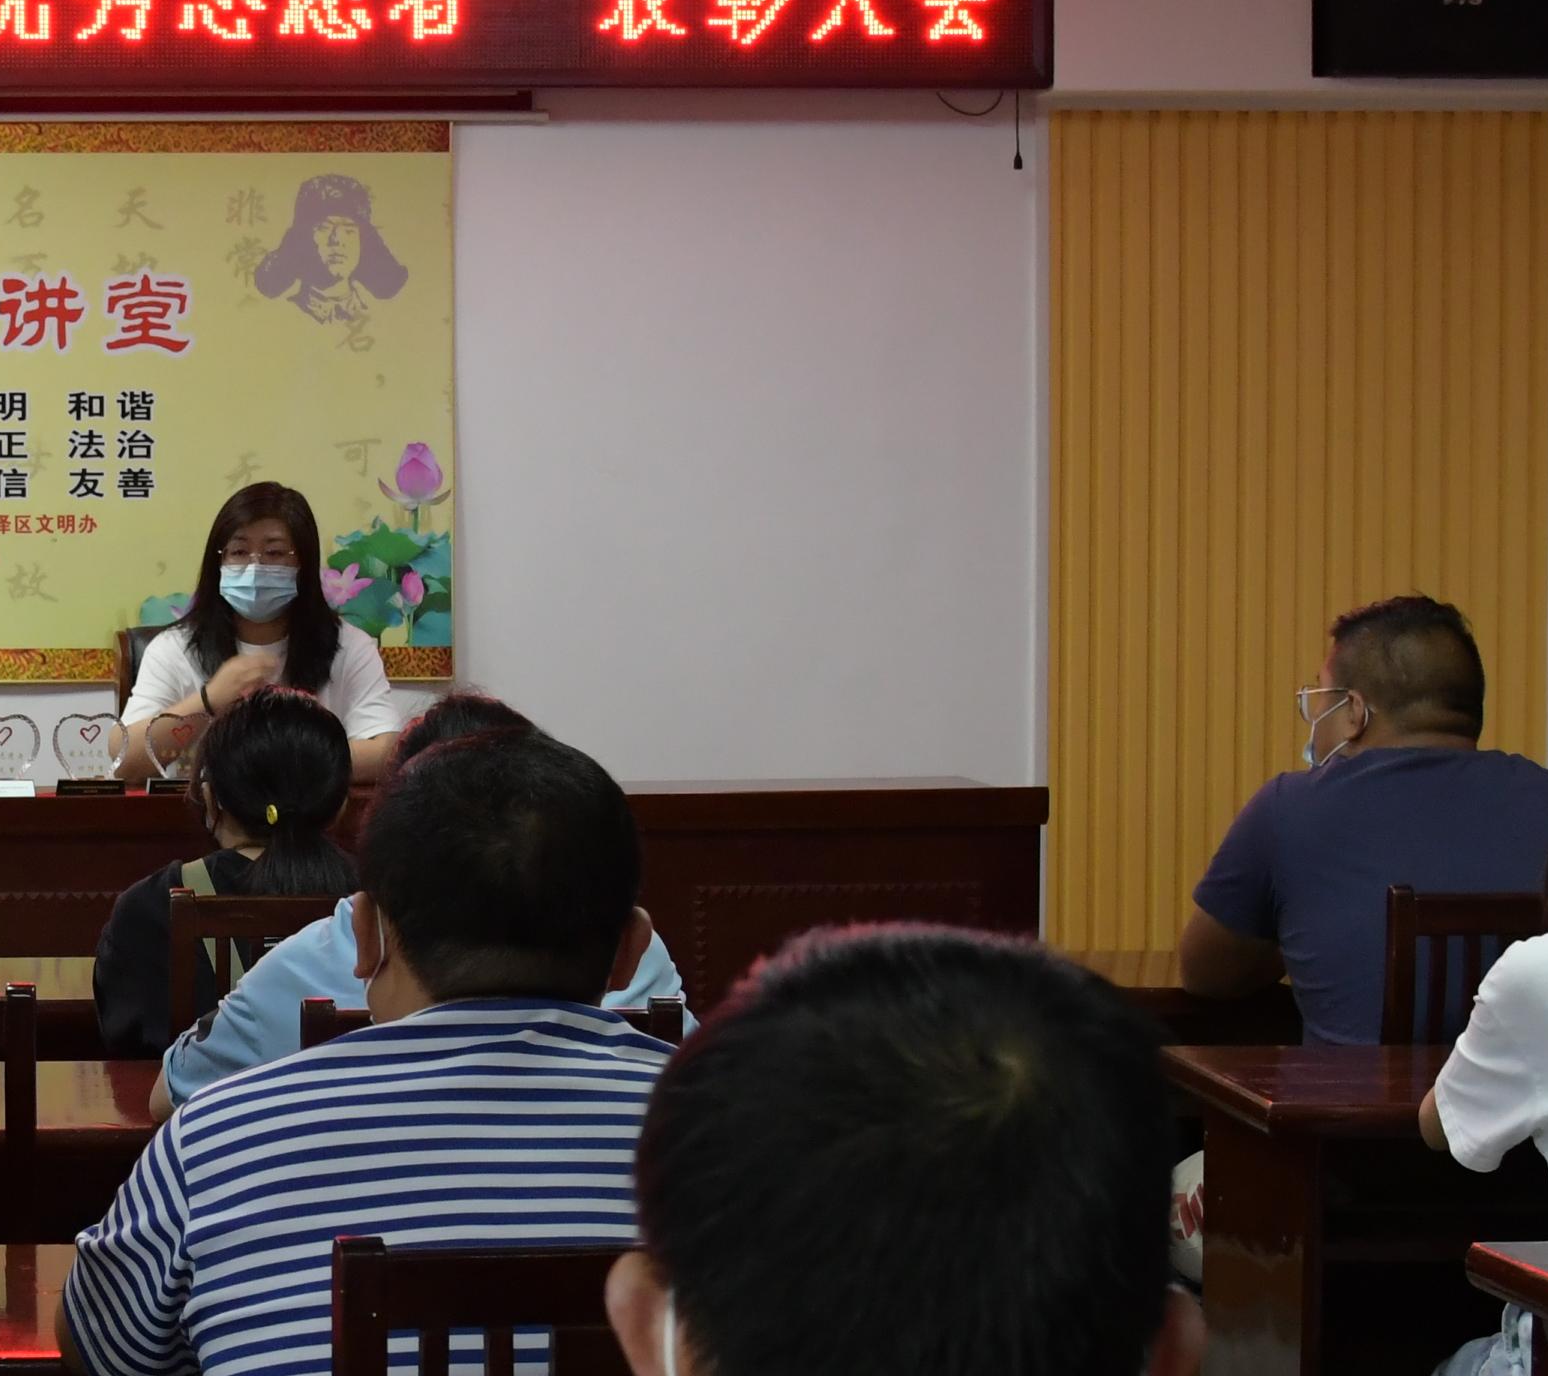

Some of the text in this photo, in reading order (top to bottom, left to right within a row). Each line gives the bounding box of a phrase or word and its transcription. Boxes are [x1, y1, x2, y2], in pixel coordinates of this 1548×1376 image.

[68, 391, 154, 421] 和谐
[68, 429, 154, 459] 法治
[69, 468, 154, 498] 友善
